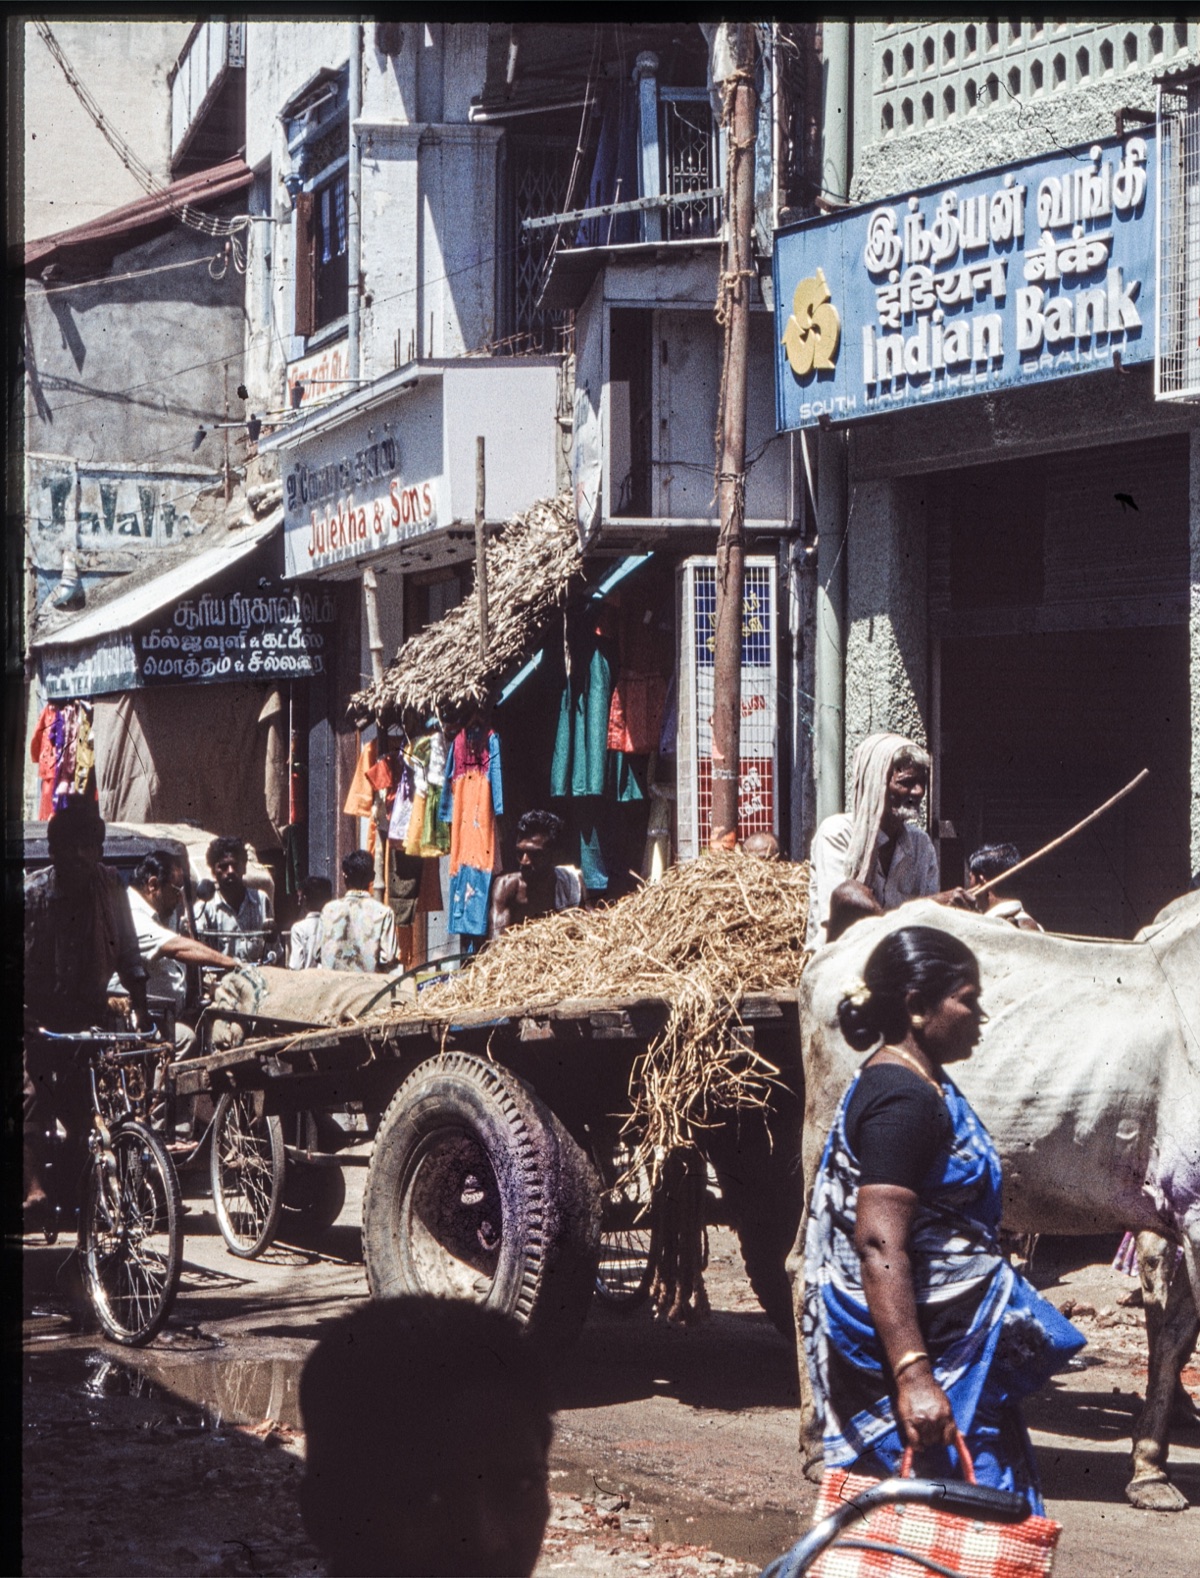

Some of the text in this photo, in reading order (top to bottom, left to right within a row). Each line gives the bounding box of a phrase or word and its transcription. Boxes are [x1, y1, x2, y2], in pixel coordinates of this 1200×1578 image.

[864, 138, 1148, 273] இந்தியன் வங்கி
[862, 267, 1143, 385] Indian Bank
[874, 258, 1008, 328] इंडियन
[799, 397, 856, 420] SOUTH
[308, 479, 434, 557] Julekha & Sons
